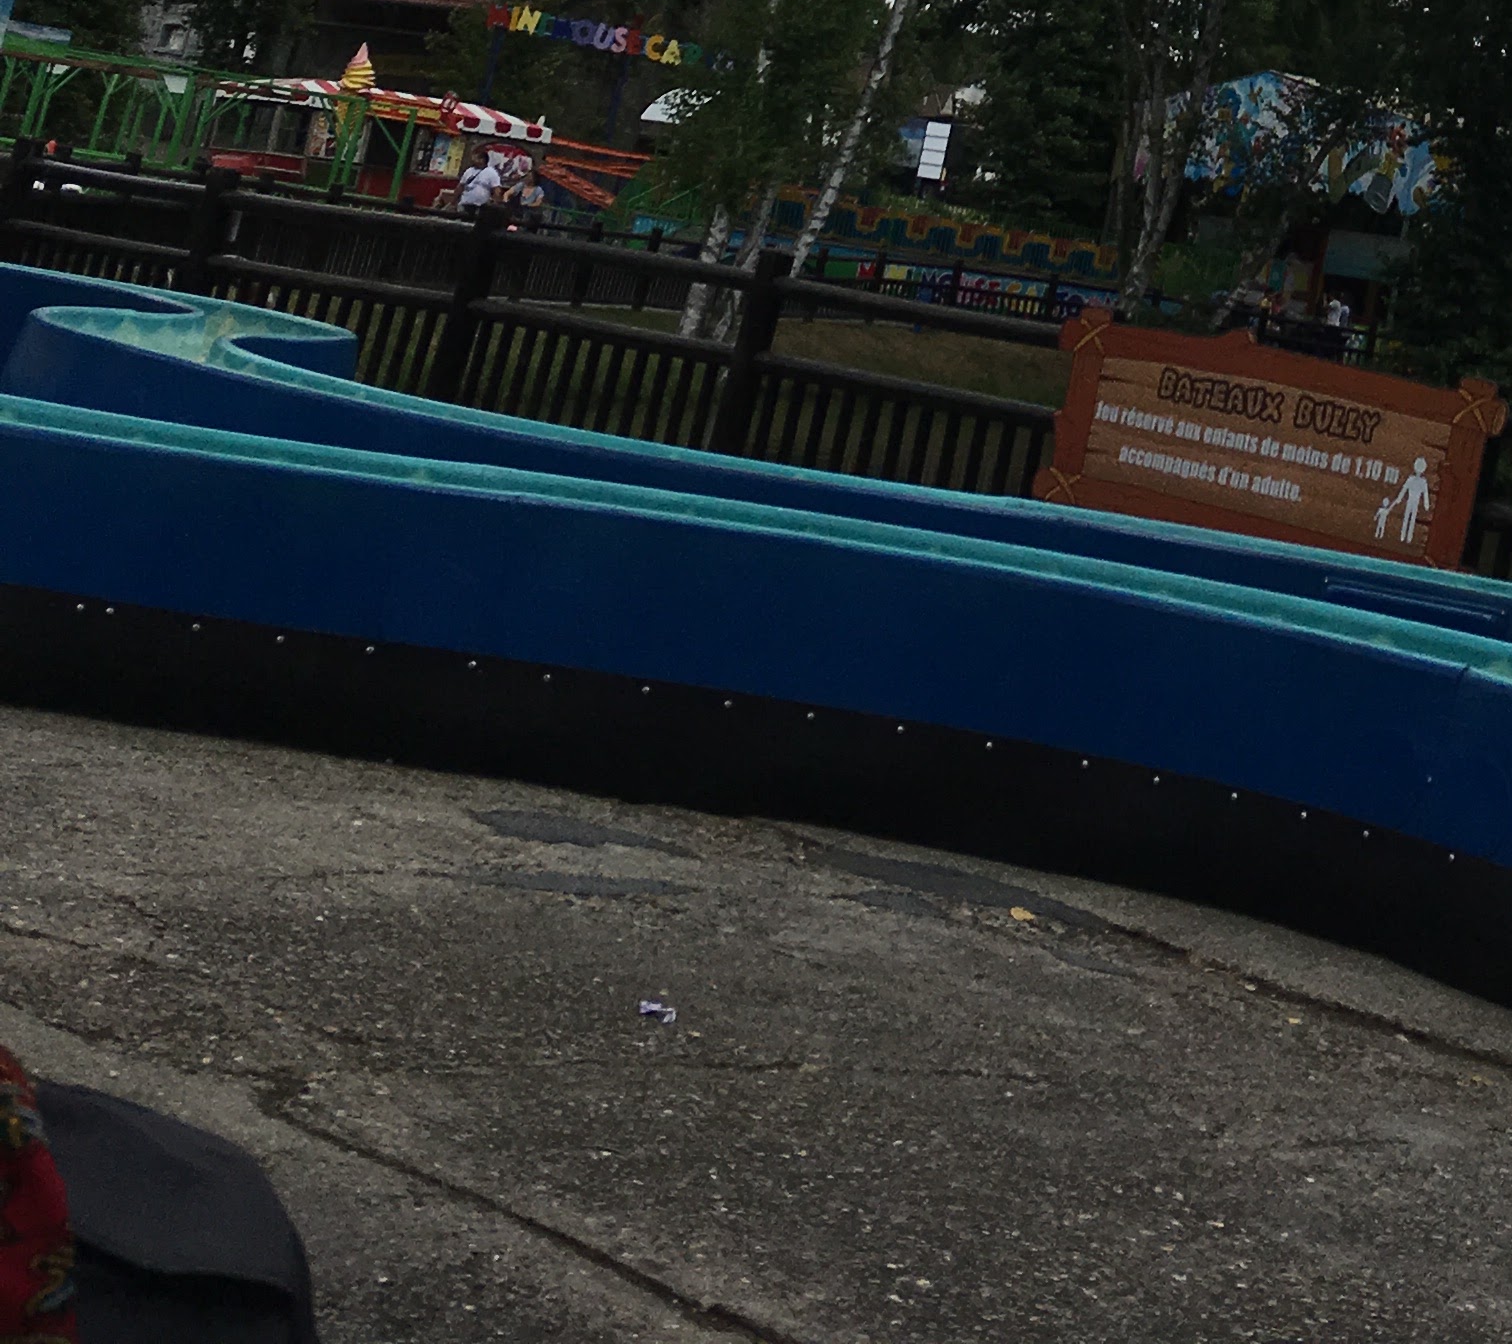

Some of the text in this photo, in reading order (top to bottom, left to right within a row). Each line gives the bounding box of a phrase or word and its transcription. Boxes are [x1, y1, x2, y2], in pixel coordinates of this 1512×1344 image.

[1157, 367, 1382, 443] BATEAUX BULLY
[1118, 445, 1216, 482] accompagnés
[1217, 466, 1250, 490] d'un
[1120, 406, 1174, 435] réservé
[1175, 421, 1202, 441] aux
[1203, 426, 1259, 454] enfants
[1260, 435, 1281, 457] de
[1281, 442, 1329, 469] moins
[1331, 451, 1352, 474] de
[1384, 465, 1400, 485] m
